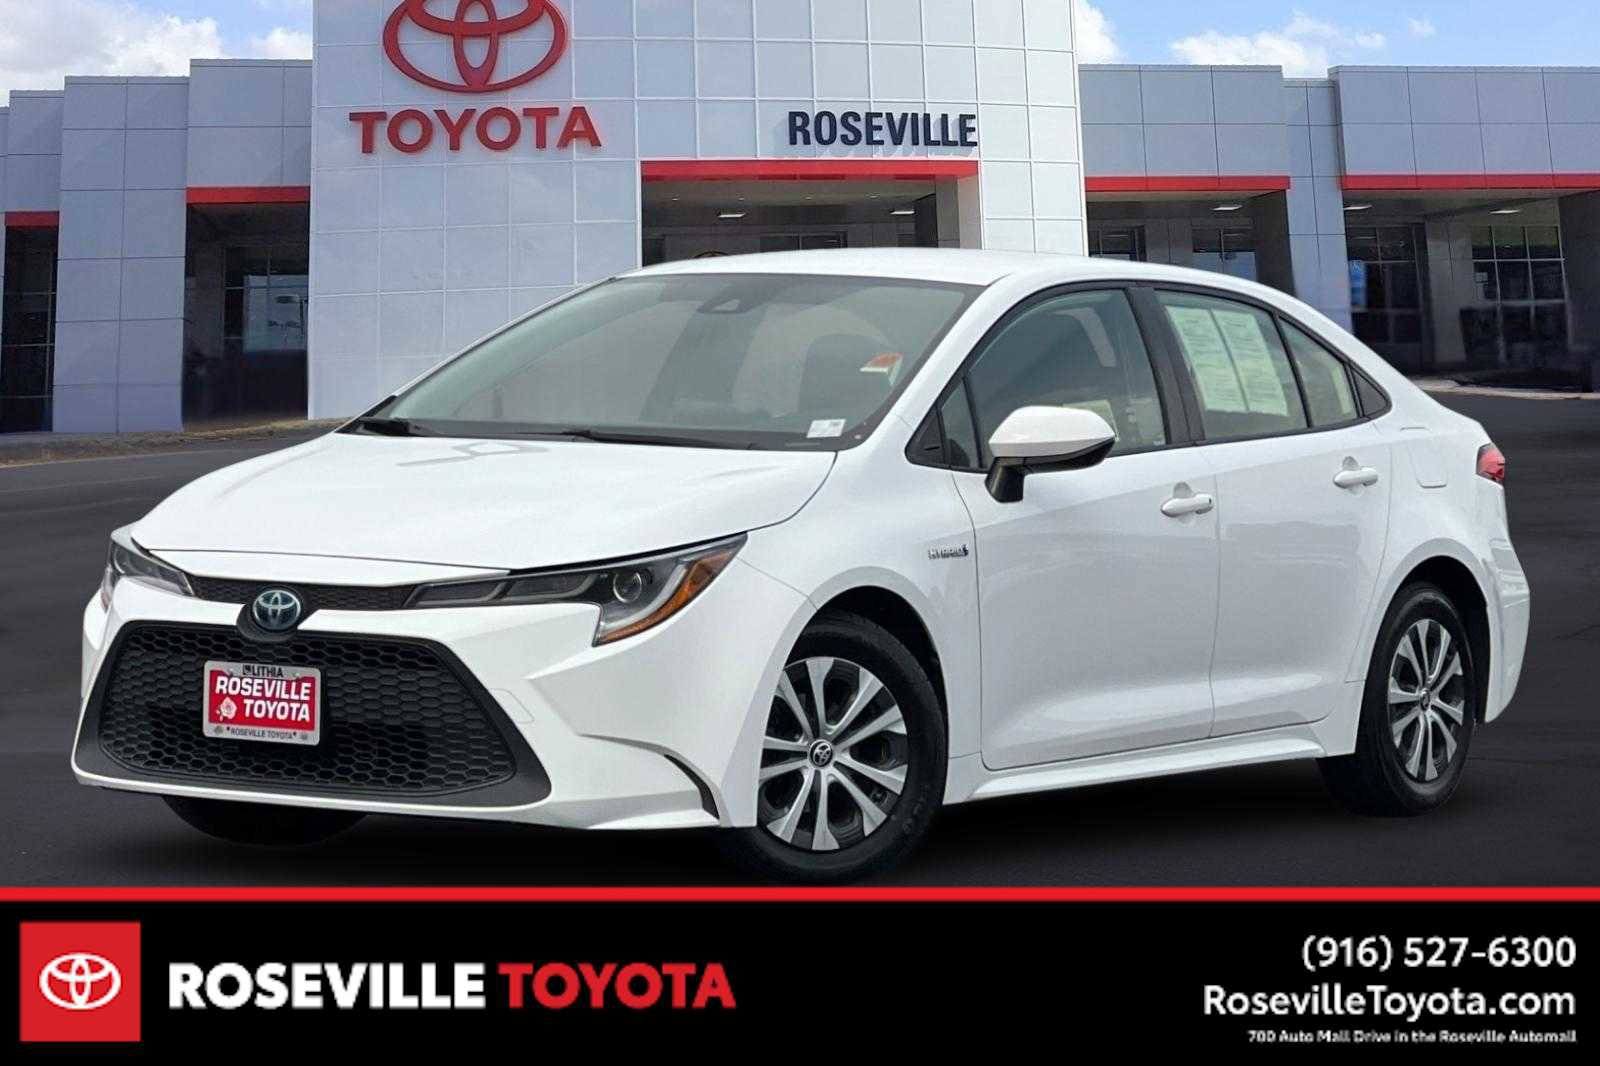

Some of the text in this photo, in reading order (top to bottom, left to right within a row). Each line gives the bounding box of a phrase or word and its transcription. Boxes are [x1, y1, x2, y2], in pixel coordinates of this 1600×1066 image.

[349, 106, 602, 153] TOYOTA
[789, 111, 978, 147] ROSEVILLE
[252, 664, 284, 678] LITHIA
[215, 675, 312, 701] ROSEVILLE
[243, 698, 310, 723] TOYOTA
